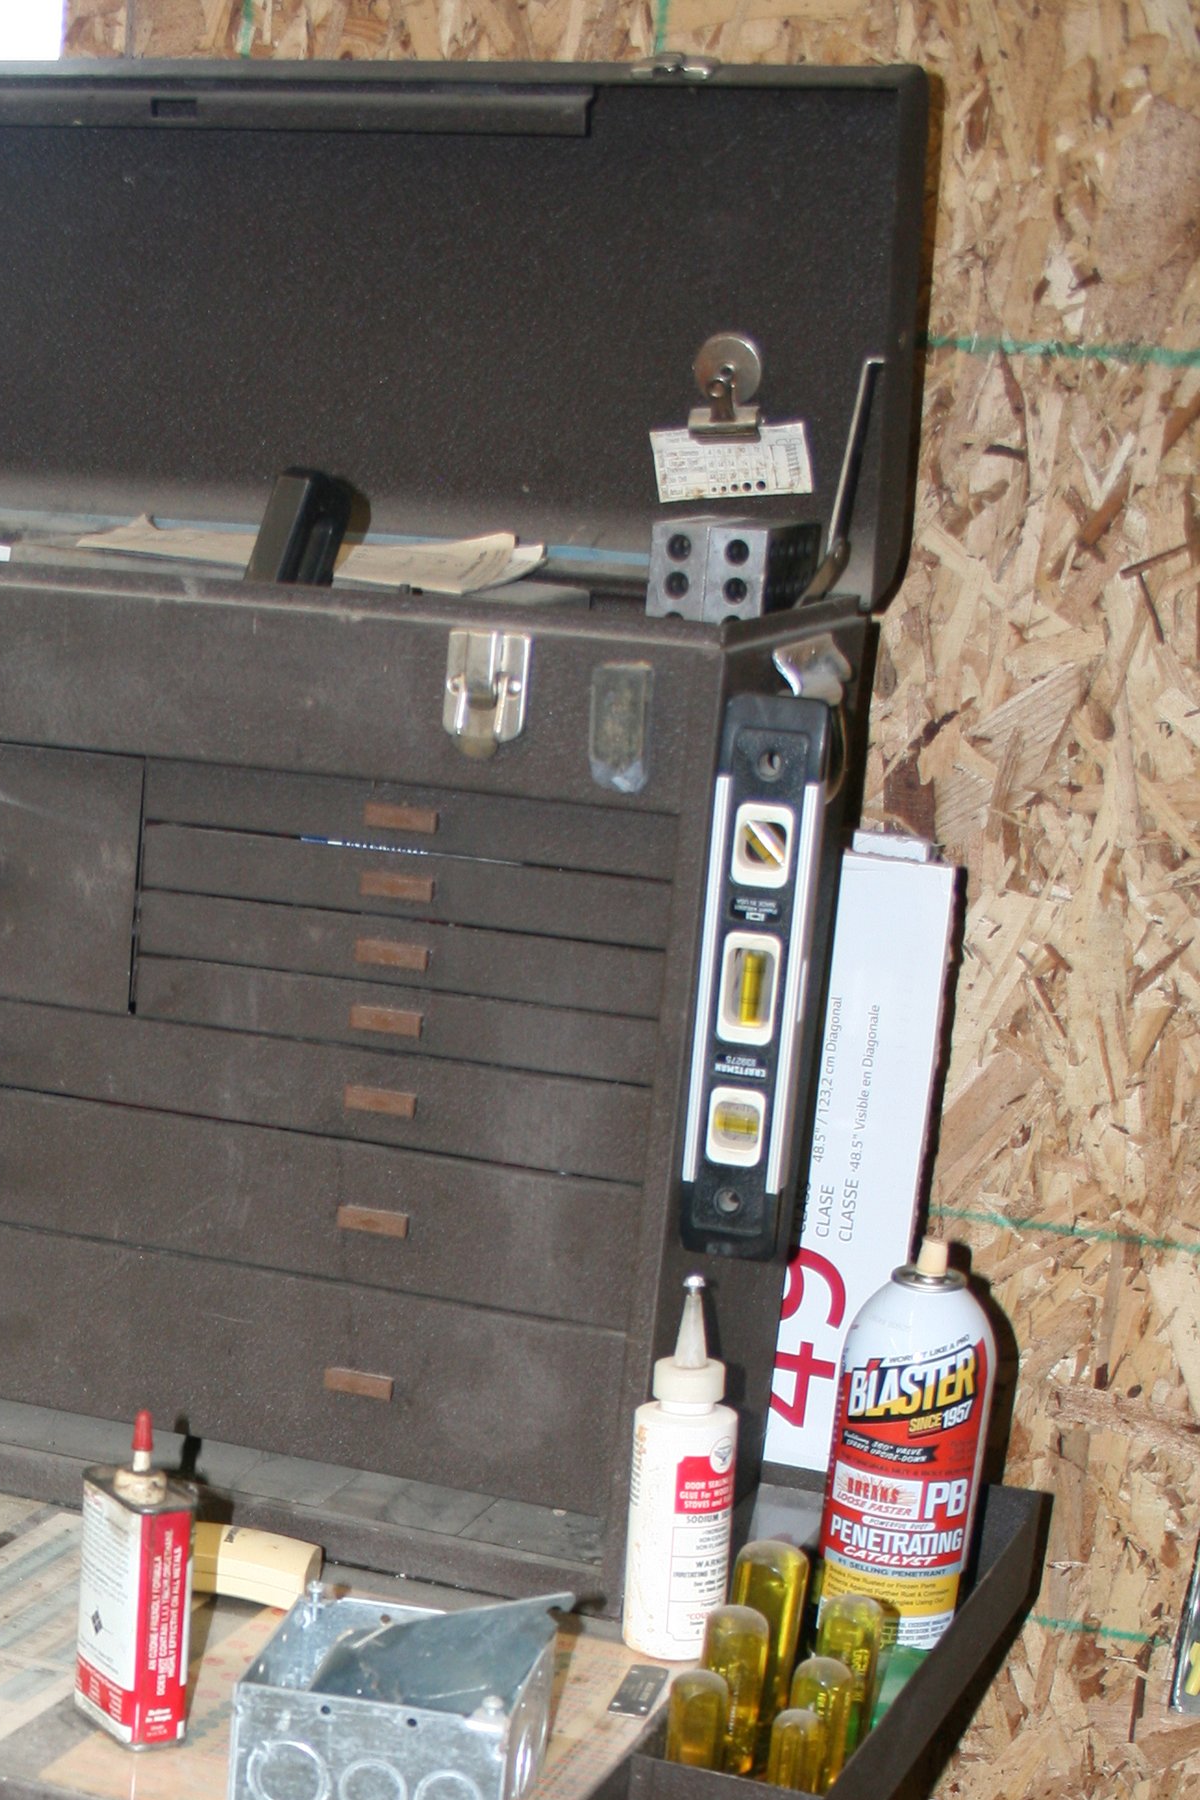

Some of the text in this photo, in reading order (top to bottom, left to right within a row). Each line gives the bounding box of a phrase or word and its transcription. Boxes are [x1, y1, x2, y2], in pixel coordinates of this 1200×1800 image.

[825, 996, 842, 1053] Diagonal
[862, 1004, 880, 1068] Diagonale
[714, 1062, 766, 1077] CRAFTSMAN
[825, 1056, 836, 1075] cm
[862, 1070, 872, 1087] en
[818, 1077, 834, 1113] 123,2
[853, 1088, 869, 1132] Visible
[813, 1126, 826, 1163] 48.5"
[815, 1184, 835, 1238] CLASE
[838, 1178, 860, 1243] CLASSE
[770, 1247, 847, 1428] 49
[929, 1346, 947, 1357] LIKE
[957, 1334, 970, 1347] PRO
[909, 1400, 973, 1433] SINCE 1957
[896, 1447, 924, 1455] VALVE
[679, 1491, 698, 1499] GLUE
[685, 1481, 706, 1489] DOOR
[847, 1477, 900, 1503] BREAKS
[684, 1499, 710, 1508] STOVES
[711, 1498, 722, 1507] and
[836, 1491, 912, 1516] LOOSE FASTER
[924, 1478, 968, 1519] PB
[687, 1513, 719, 1523] SODIUM
[830, 1515, 962, 1557] PENETRATING
[843, 1546, 937, 1566] CATALYST
[850, 1562, 888, 1576] SELLING
[891, 1569, 946, 1578] PENETRANT
[172, 1579, 180, 1594] ALL
[148, 1658, 156, 1670] AN
[153, 1555, 162, 1593] FORMULA
[171, 1594, 179, 1607] ON
[159, 1626, 168, 1657] CONTAIN
[168, 1608, 178, 1650] EFFECTIVE
[158, 1657, 169, 1674] NOT
[157, 1674, 166, 1696] DOES
